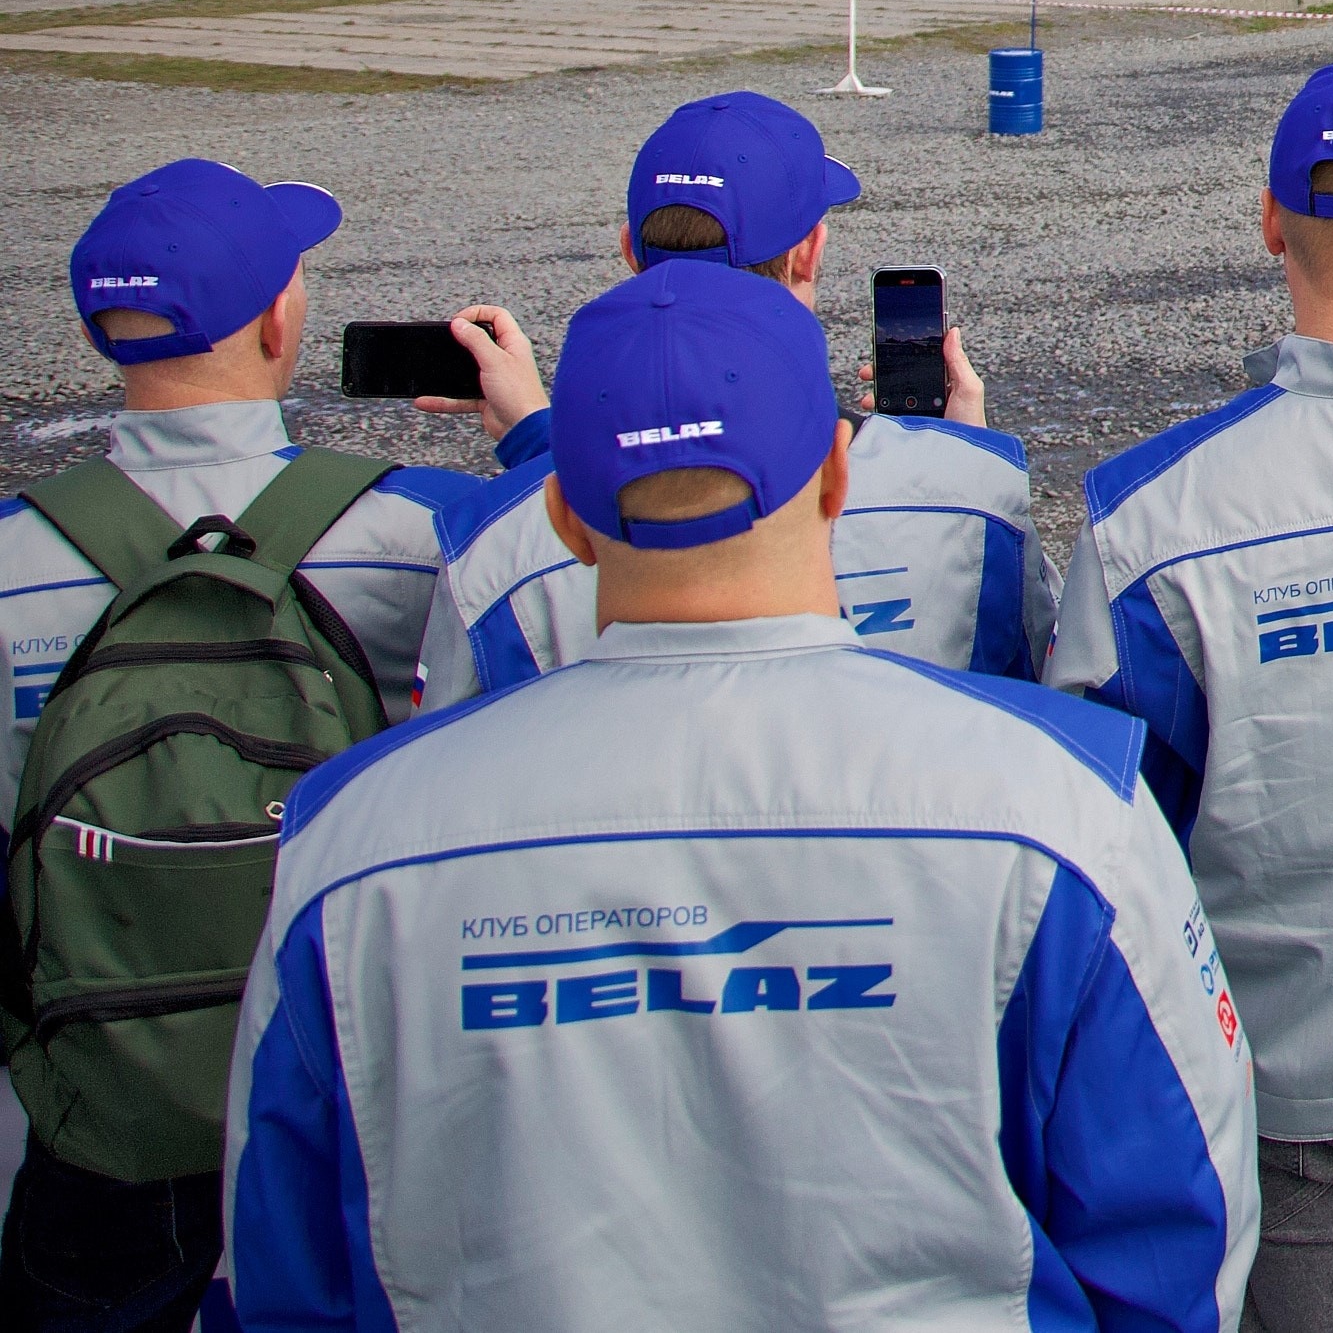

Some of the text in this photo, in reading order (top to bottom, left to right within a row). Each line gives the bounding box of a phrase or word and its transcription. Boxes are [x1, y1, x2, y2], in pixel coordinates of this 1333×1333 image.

[655, 174, 724, 188] BELAZ
[90, 276, 159, 289] BELAZ
[616, 420, 724, 448] BELAZ
[1253, 583, 1301, 604] КЛУБ
[12, 635, 68, 655] КЛУБ
[462, 905, 709, 939] КЛУБ ОПЕРАТОРОВ
[462, 964, 897, 1030] BELAZ
